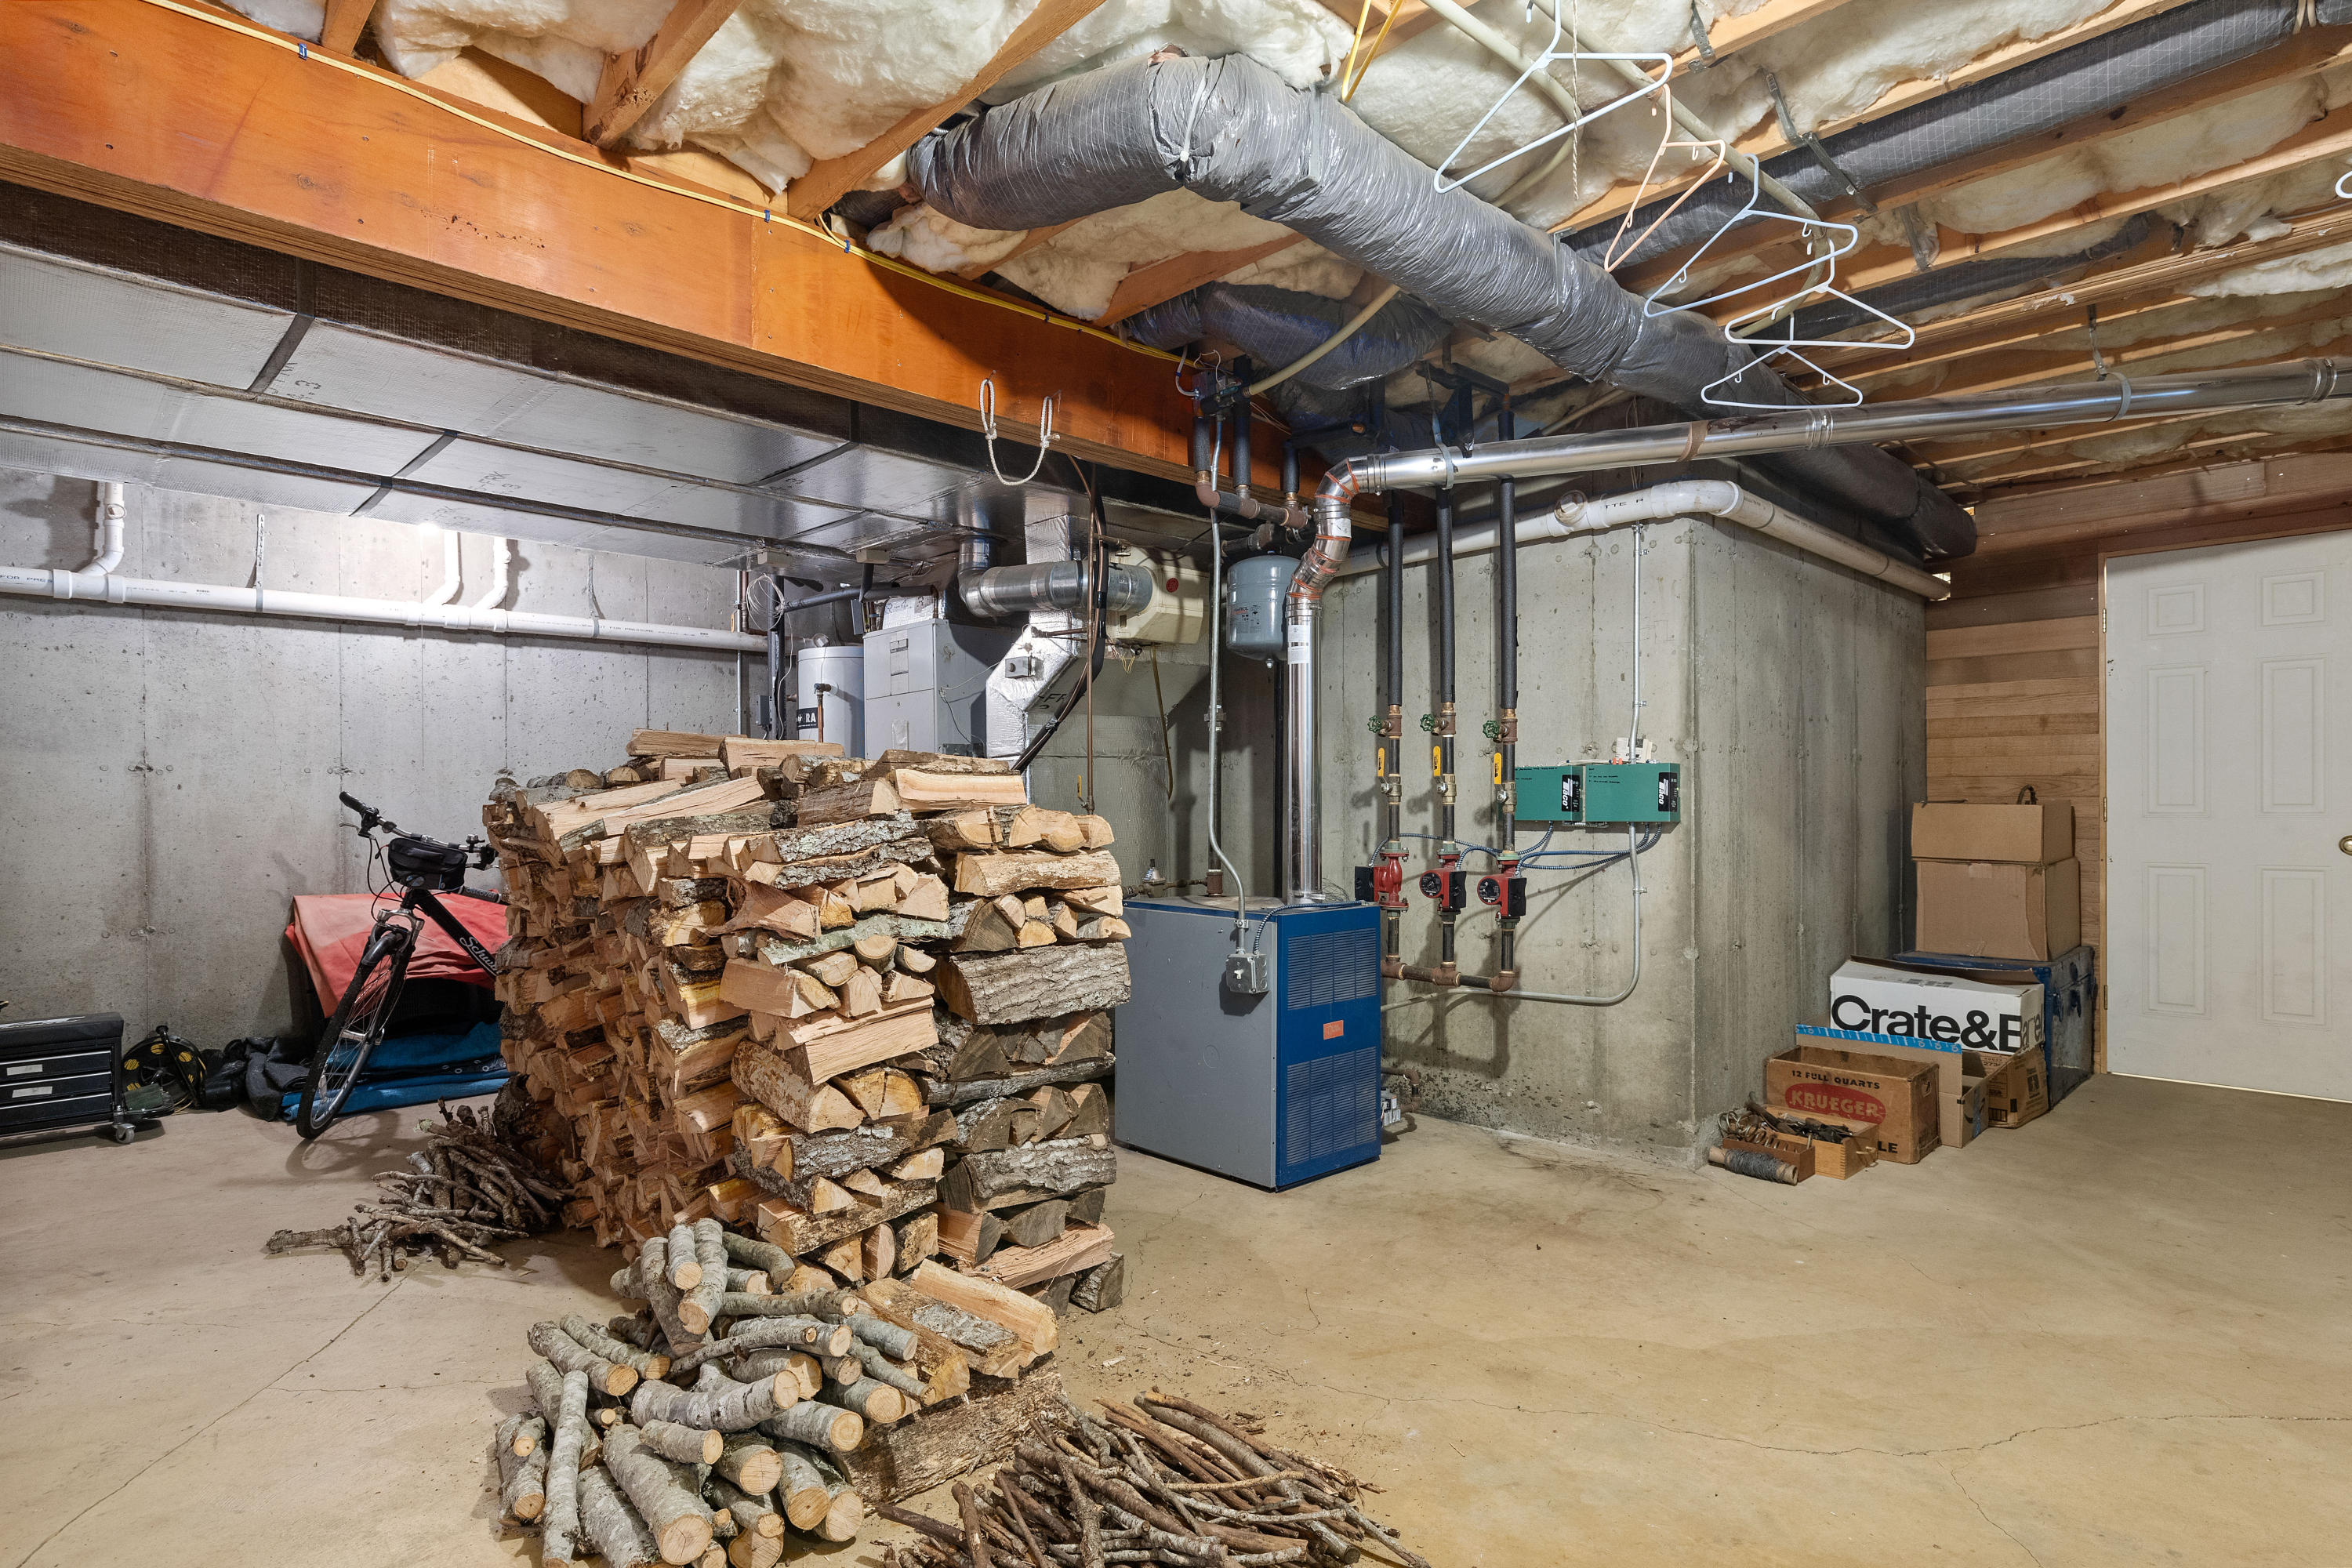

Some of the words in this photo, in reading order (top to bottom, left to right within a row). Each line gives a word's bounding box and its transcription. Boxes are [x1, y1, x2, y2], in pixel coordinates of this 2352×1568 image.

[1562, 778, 1576, 807] Taco
[1657, 778, 1669, 805] Taco
[1791, 1069, 1802, 1078] 12
[1805, 1072, 1829, 1082] FULL
[1834, 1076, 1881, 1090] QUARTS
[1791, 1090, 1881, 1117] KRUEGER
